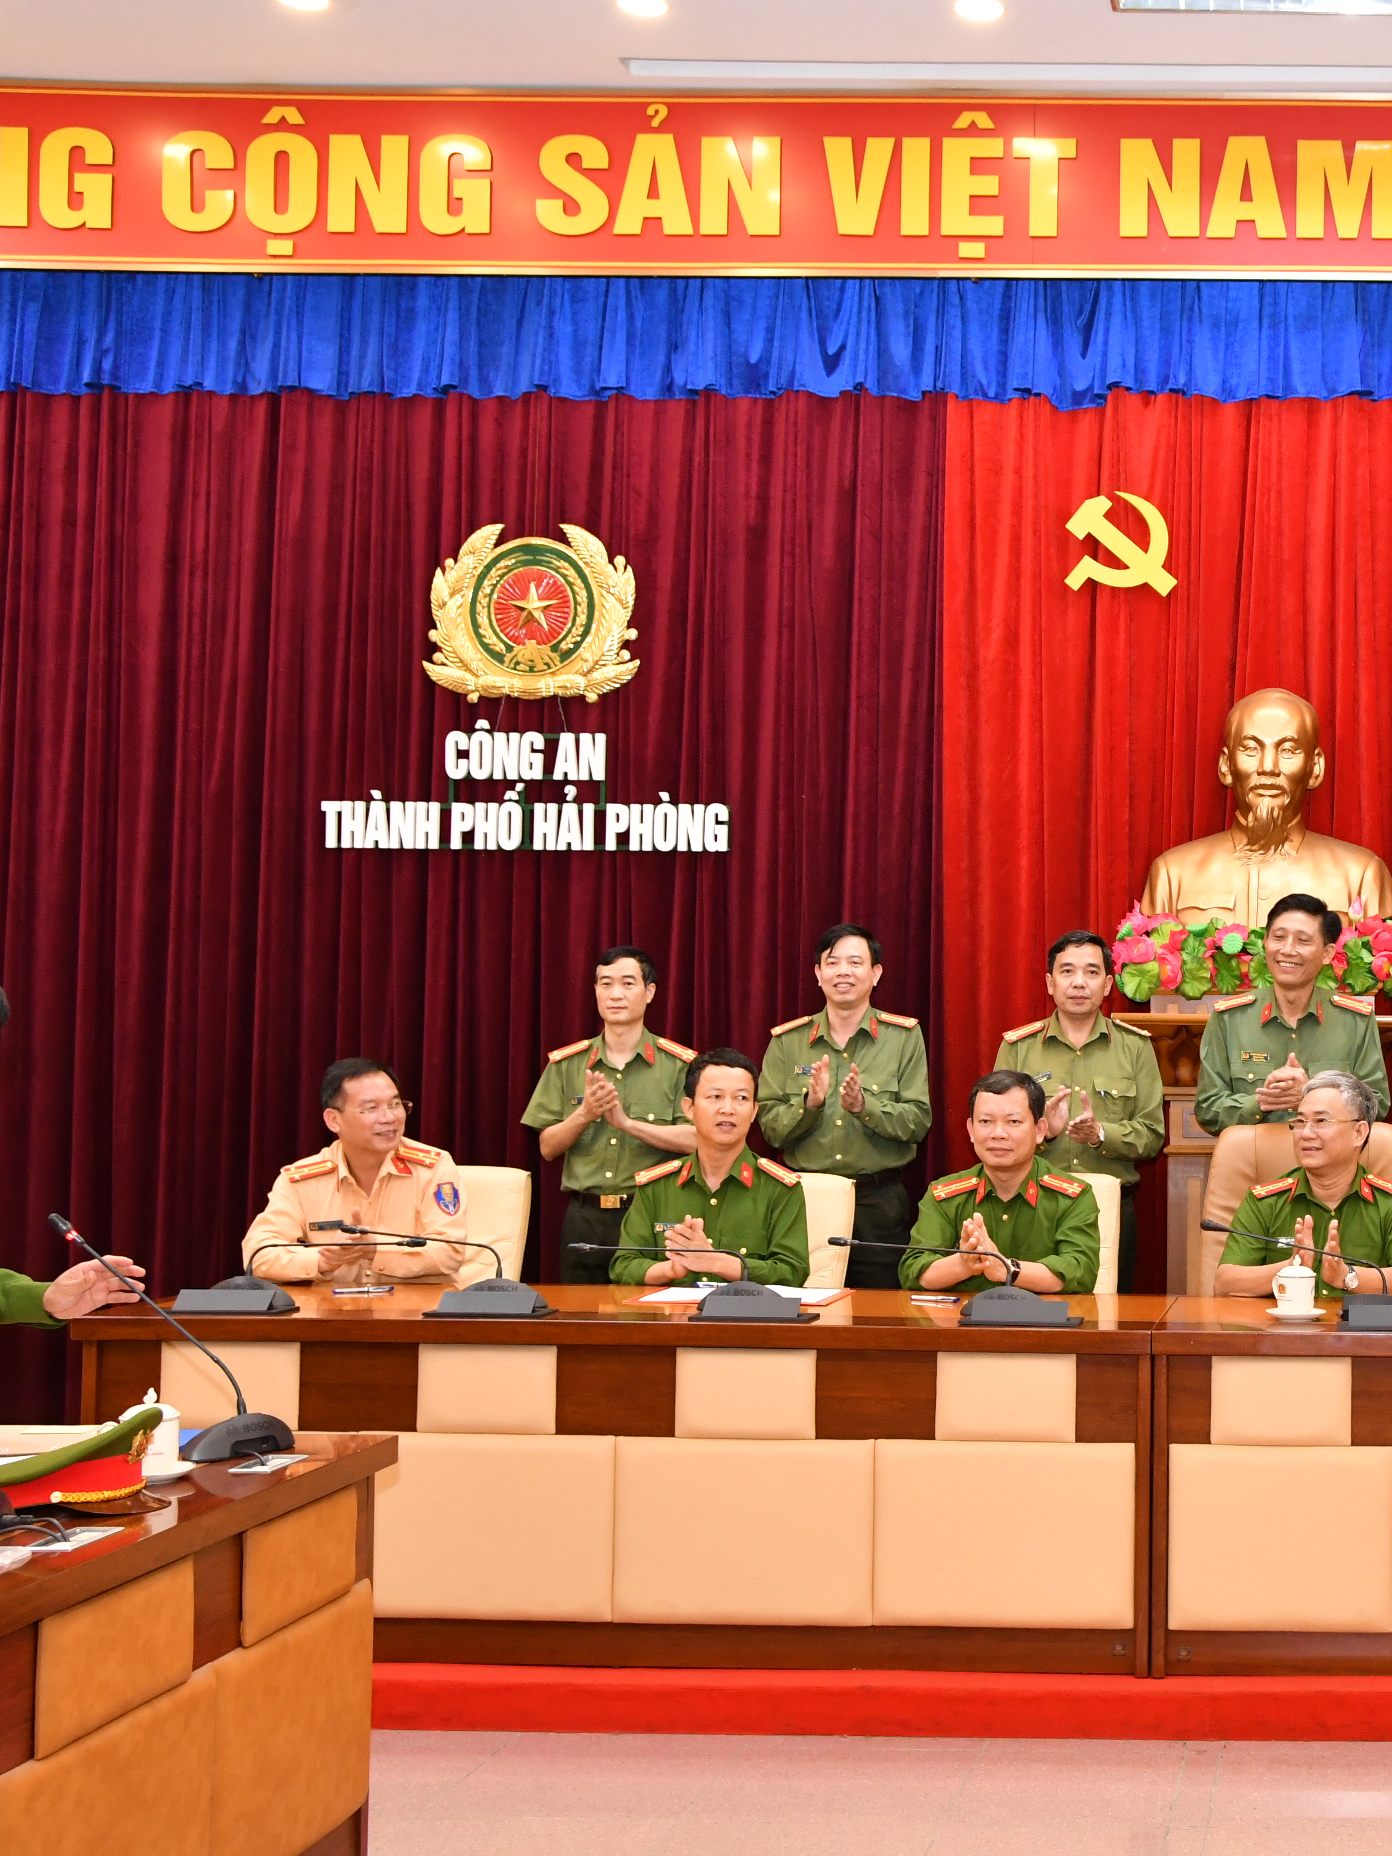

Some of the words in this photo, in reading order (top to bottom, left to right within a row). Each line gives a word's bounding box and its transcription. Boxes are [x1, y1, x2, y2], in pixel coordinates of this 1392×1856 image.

[161, 106, 492, 256] CỘNG
[535, 104, 782, 236] SẢN
[824, 111, 1078, 260] VIỆT
[445, 719, 545, 780] CÔNG
[553, 732, 607, 780] AN
[321, 789, 441, 850] THÀNH
[450, 782, 525, 851] PHỐ
[533, 784, 595, 851] HẢI
[605, 791, 729, 852] PHÒNG
[243, 1420, 273, 1433] BOSCH
